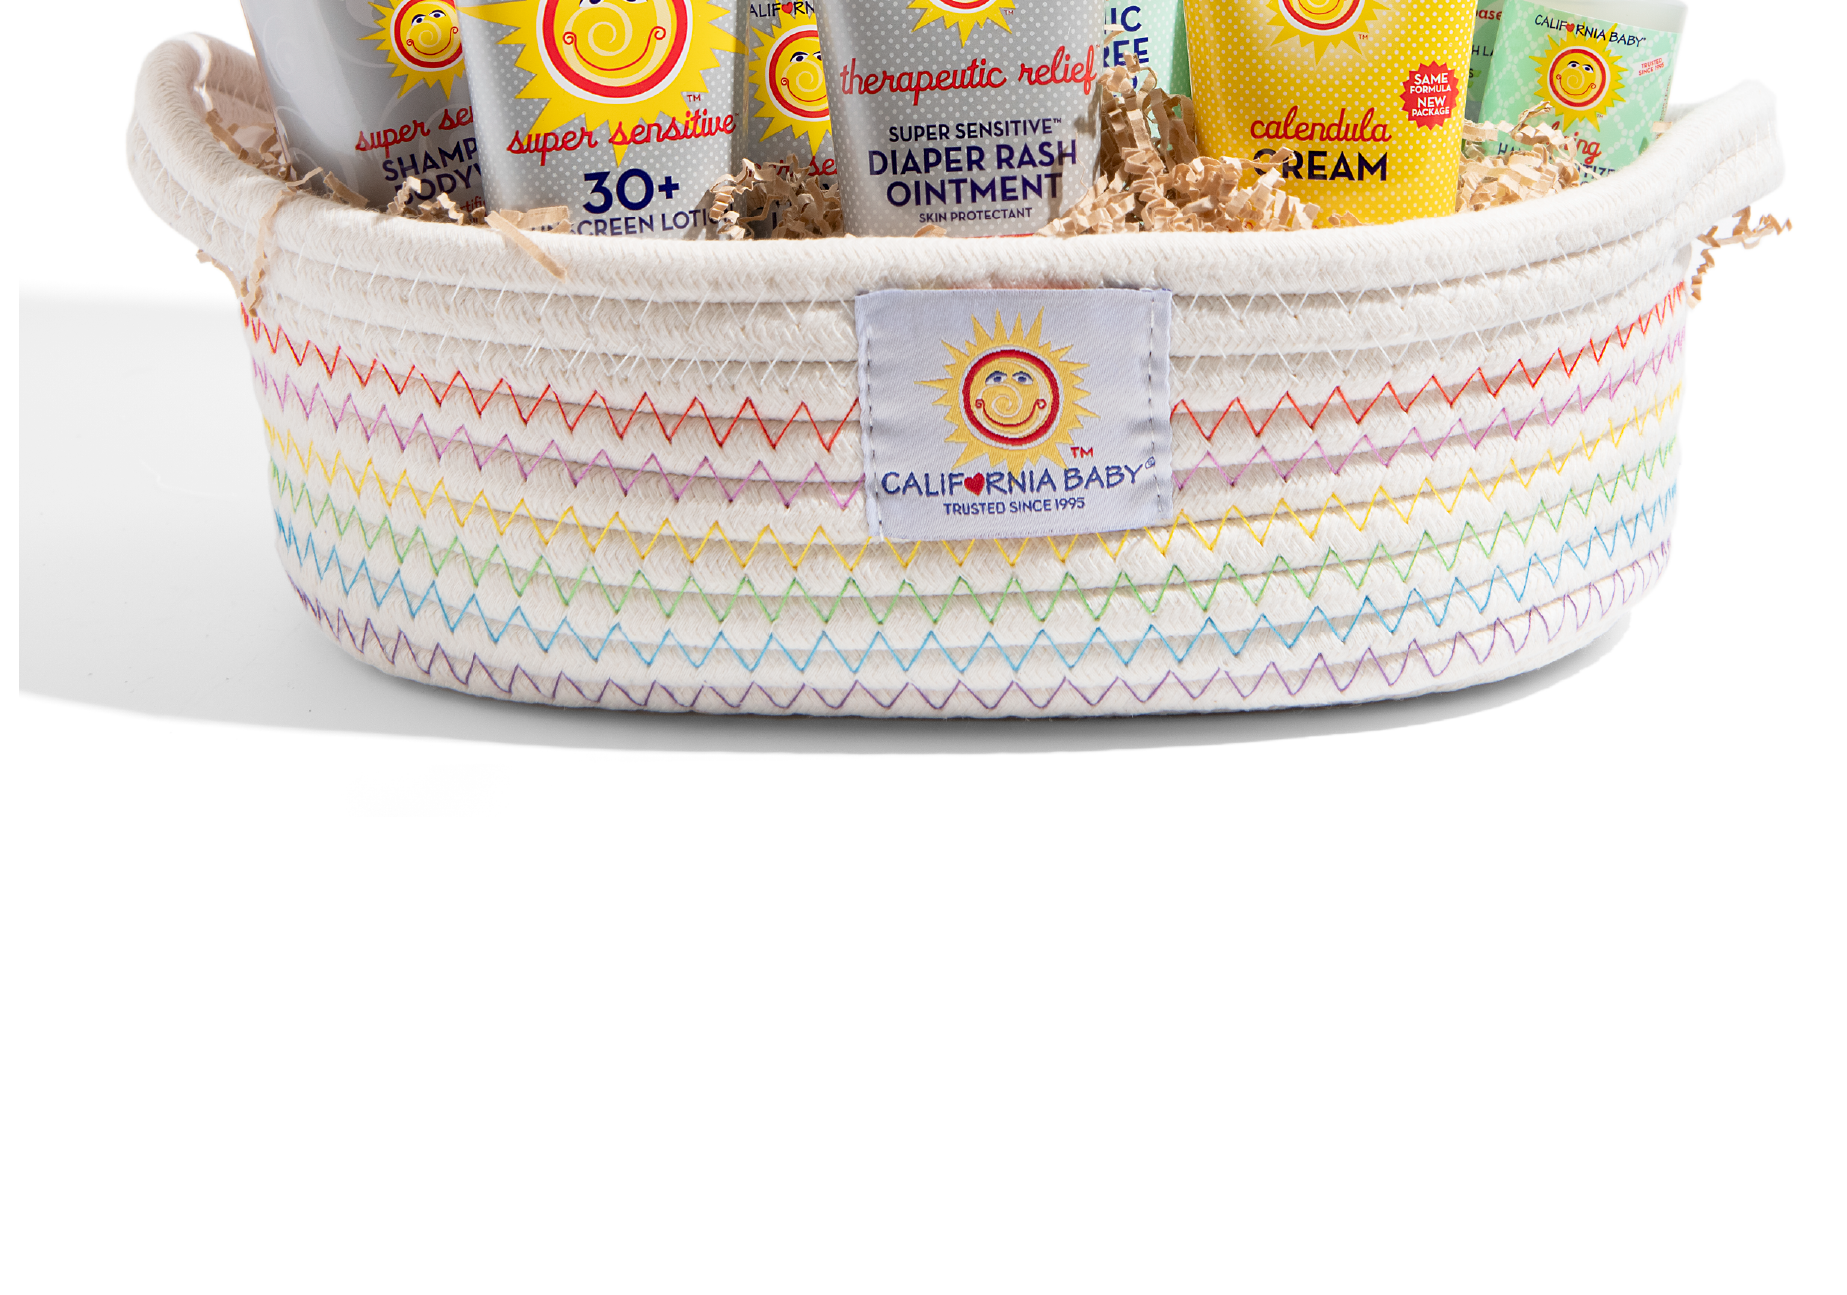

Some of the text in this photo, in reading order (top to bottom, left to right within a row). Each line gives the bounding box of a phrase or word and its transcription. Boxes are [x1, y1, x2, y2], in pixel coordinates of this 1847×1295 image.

[839, 57, 1008, 107] therapeutic
[1017, 44, 1098, 96] relief
[1413, 73, 1449, 86] SAME
[1409, 84, 1452, 95] FORMULA
[1417, 96, 1447, 108] NEW
[1249, 105, 1392, 143] calendula
[1411, 106, 1450, 117] PACKAGE
[355, 119, 431, 159] super
[507, 126, 599, 167] super
[888, 123, 951, 143] SUPER
[868, 138, 1077, 176] DIAPER RASH
[582, 167, 680, 215] 30+
[886, 172, 1063, 207] OINTMENT
[918, 207, 1033, 224] SKIN PROTECTANT
[943, 496, 1086, 516] TRUSTED SINCE 1995
